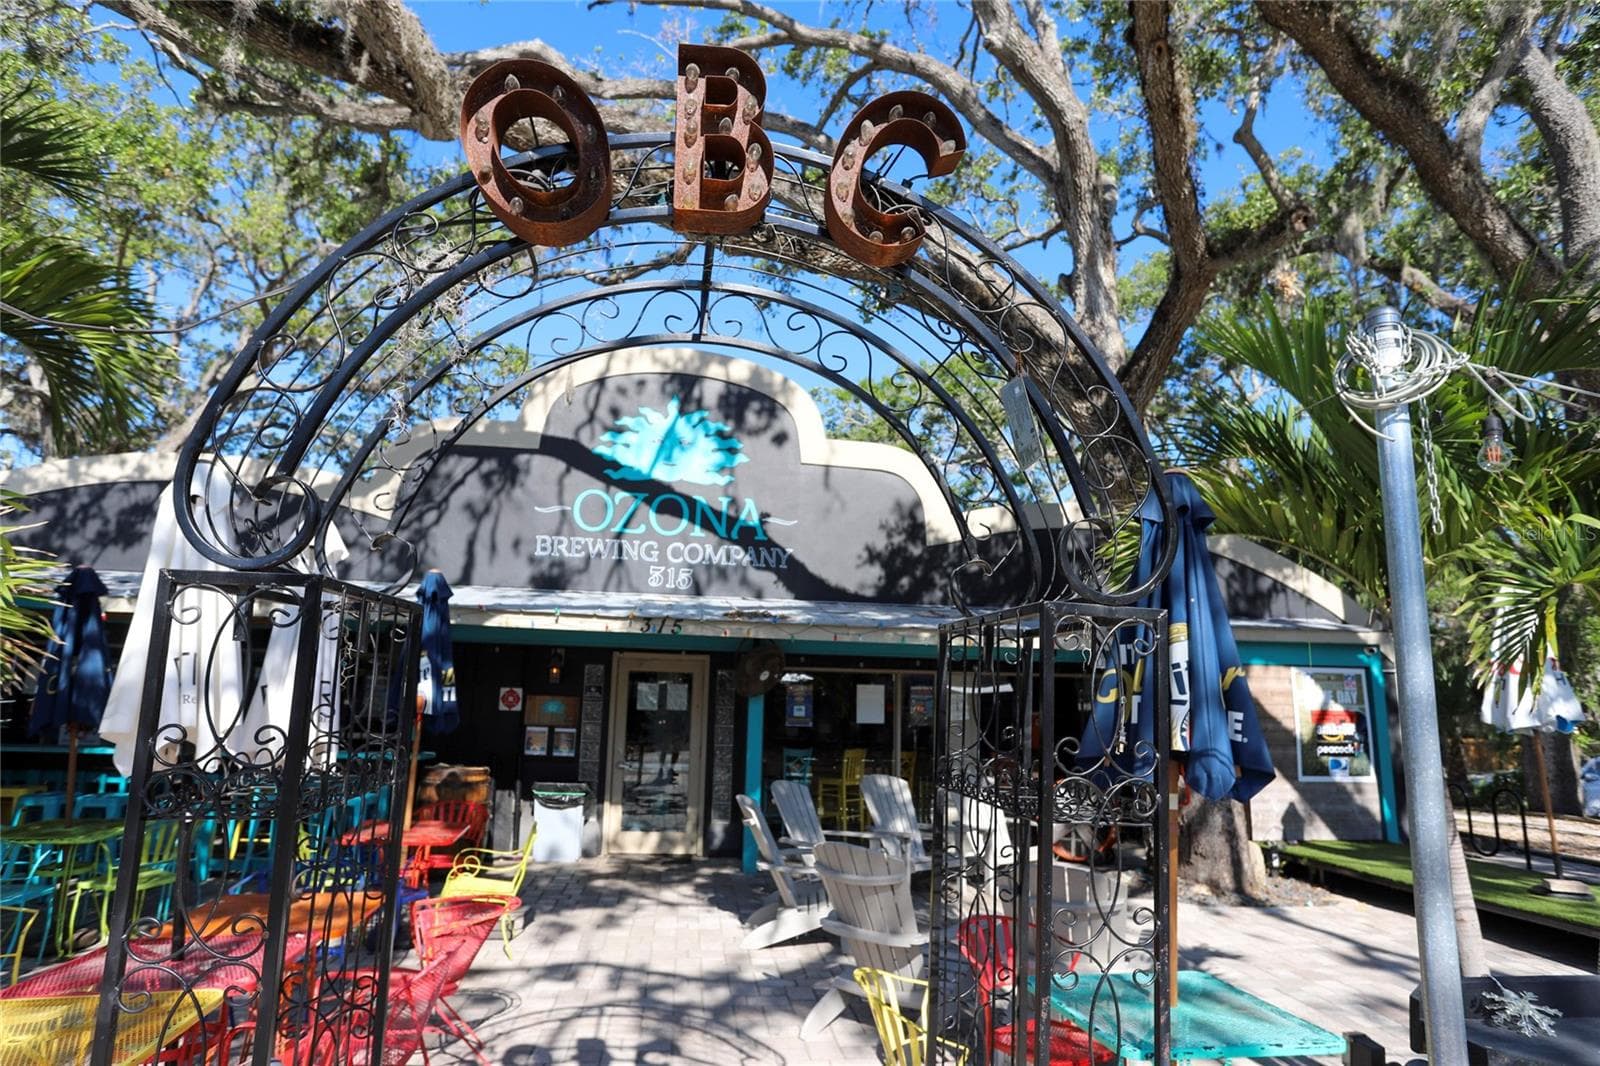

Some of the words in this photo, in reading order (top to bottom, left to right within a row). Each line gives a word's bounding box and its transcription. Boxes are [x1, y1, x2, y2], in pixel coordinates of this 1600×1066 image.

[461, 44, 965, 268] OBC
[572, 488, 768, 541] OZONA
[534, 535, 659, 563] BREWING
[666, 542, 793, 569] COMPANY
[648, 565, 693, 590] 315
[640, 616, 683, 634] 315
